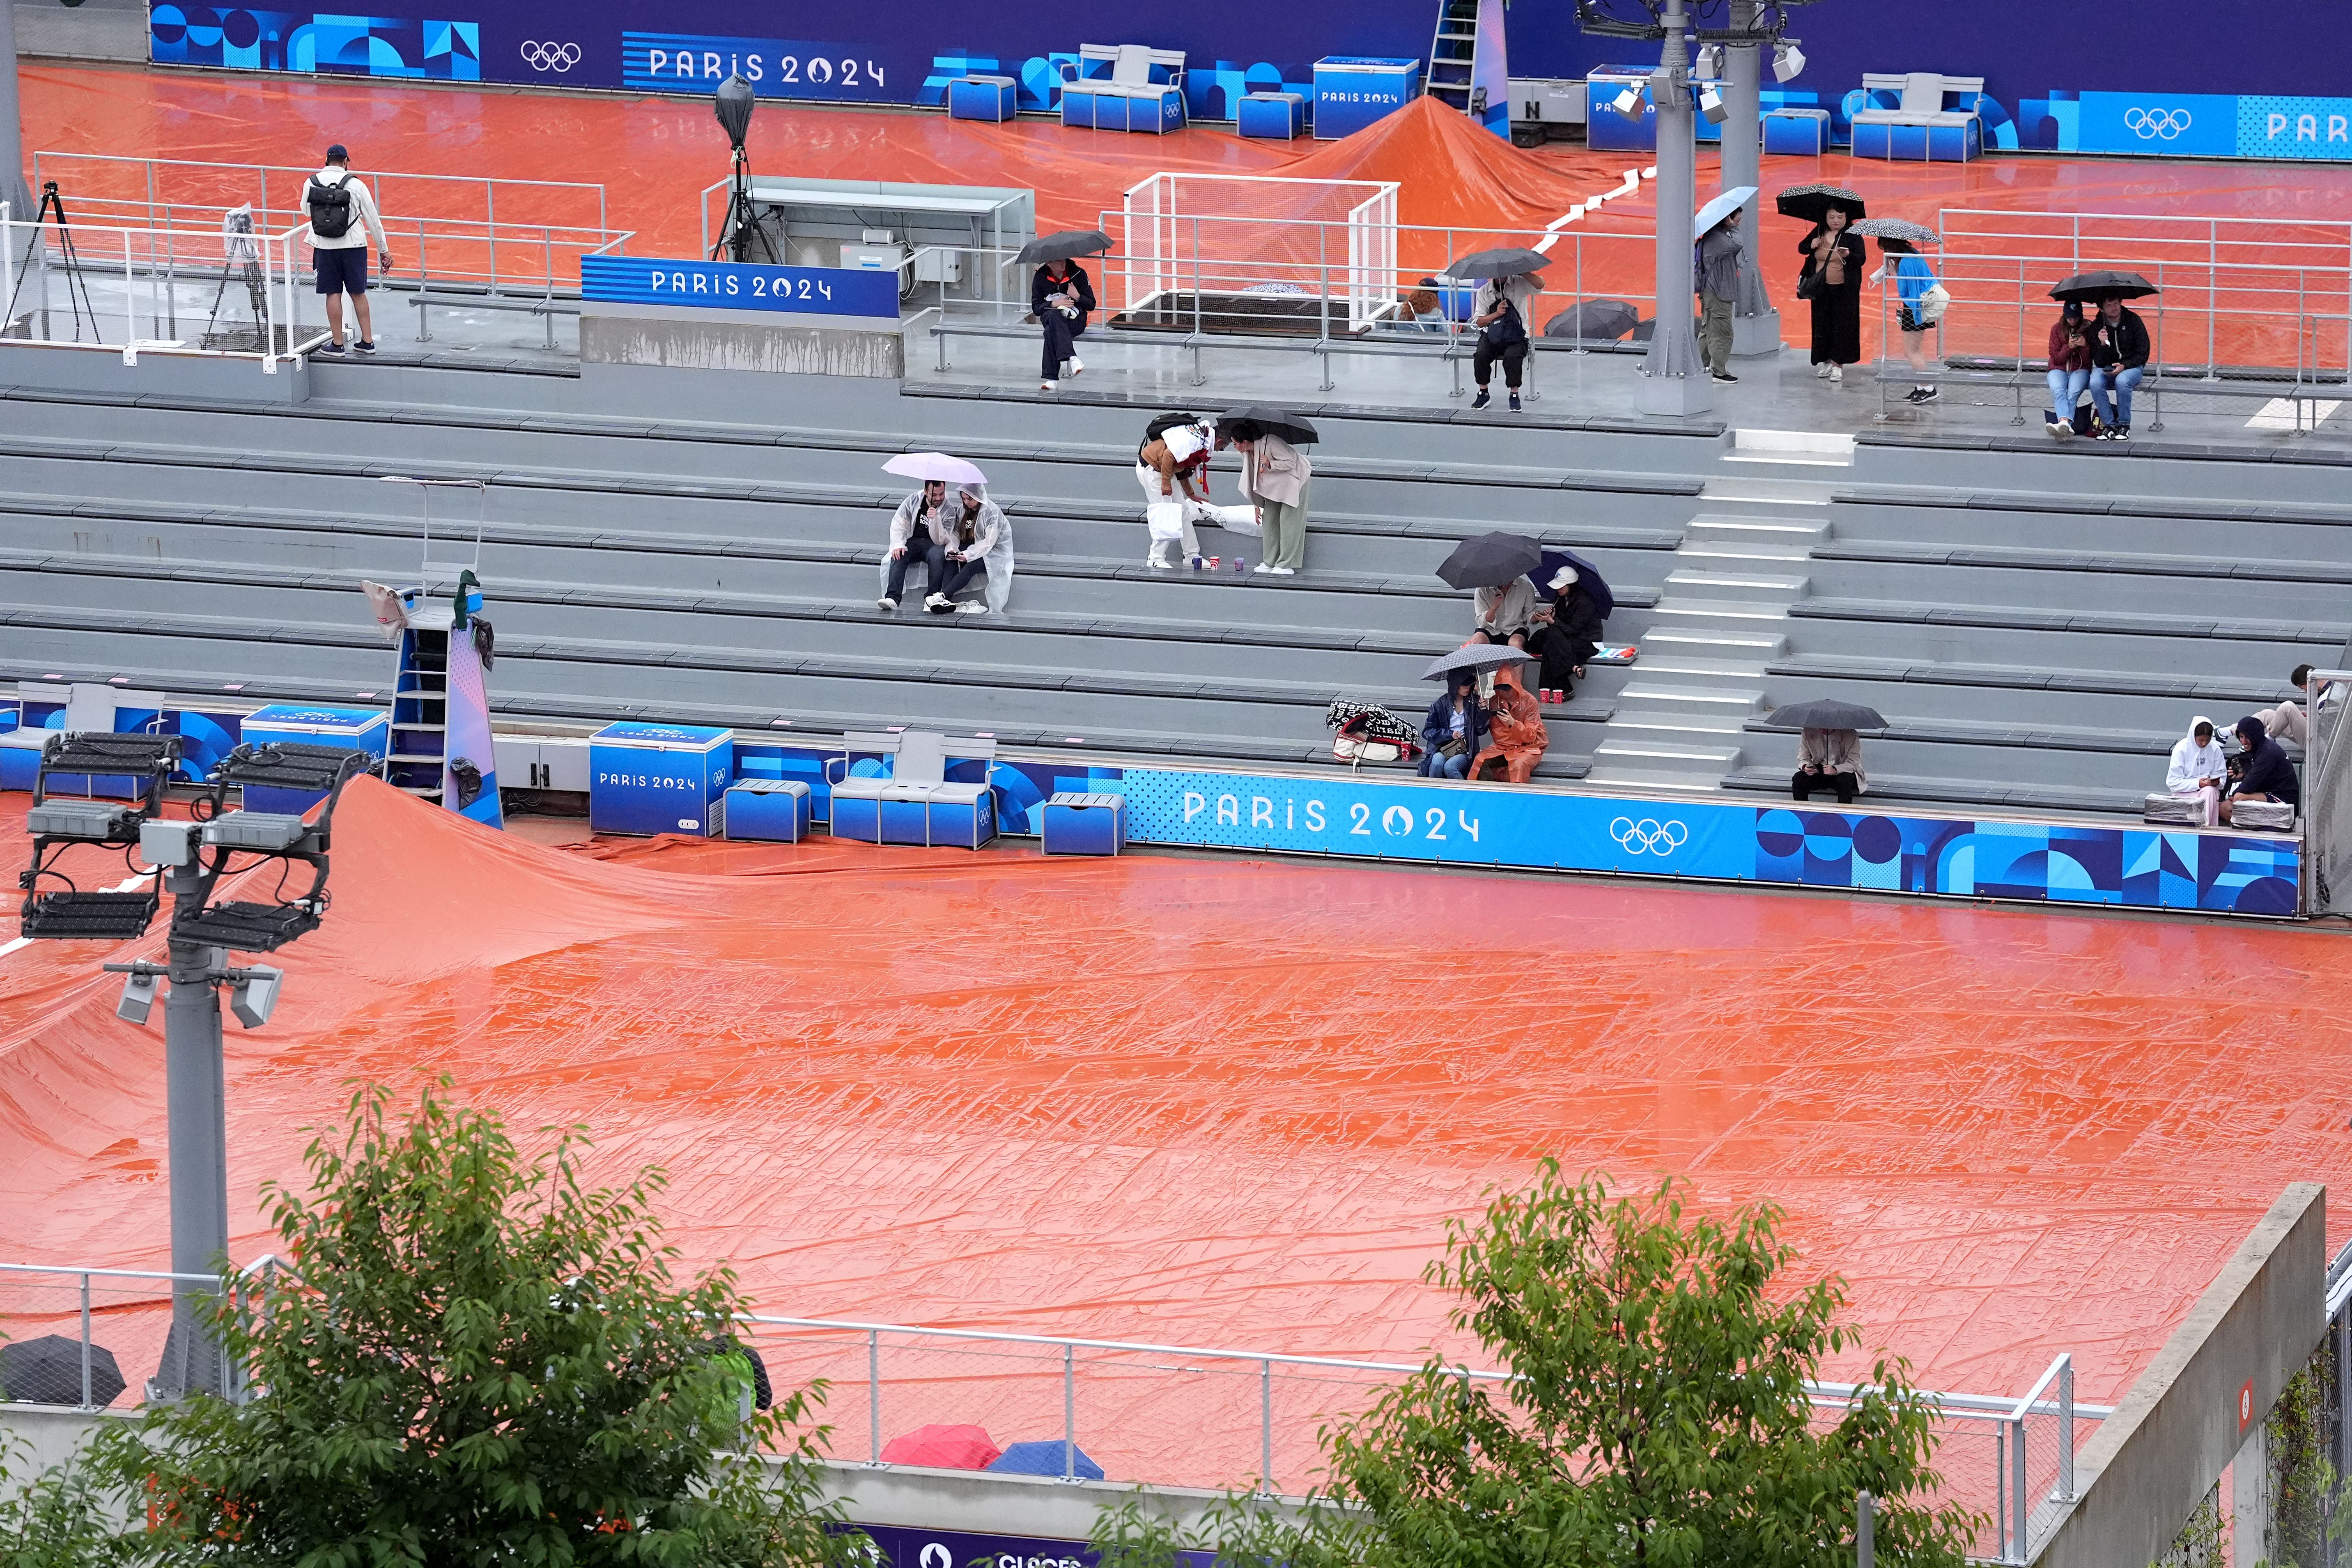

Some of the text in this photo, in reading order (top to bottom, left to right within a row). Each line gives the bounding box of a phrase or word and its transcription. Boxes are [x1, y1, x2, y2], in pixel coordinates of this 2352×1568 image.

[650, 49, 884, 87] PARIS 2024
[1322, 92, 1397, 103] PARIS 2024
[652, 271, 831, 300] PARIS 2024
[600, 773, 695, 790] PARIS 2024
[1185, 792, 1479, 842] PARIS 2024
